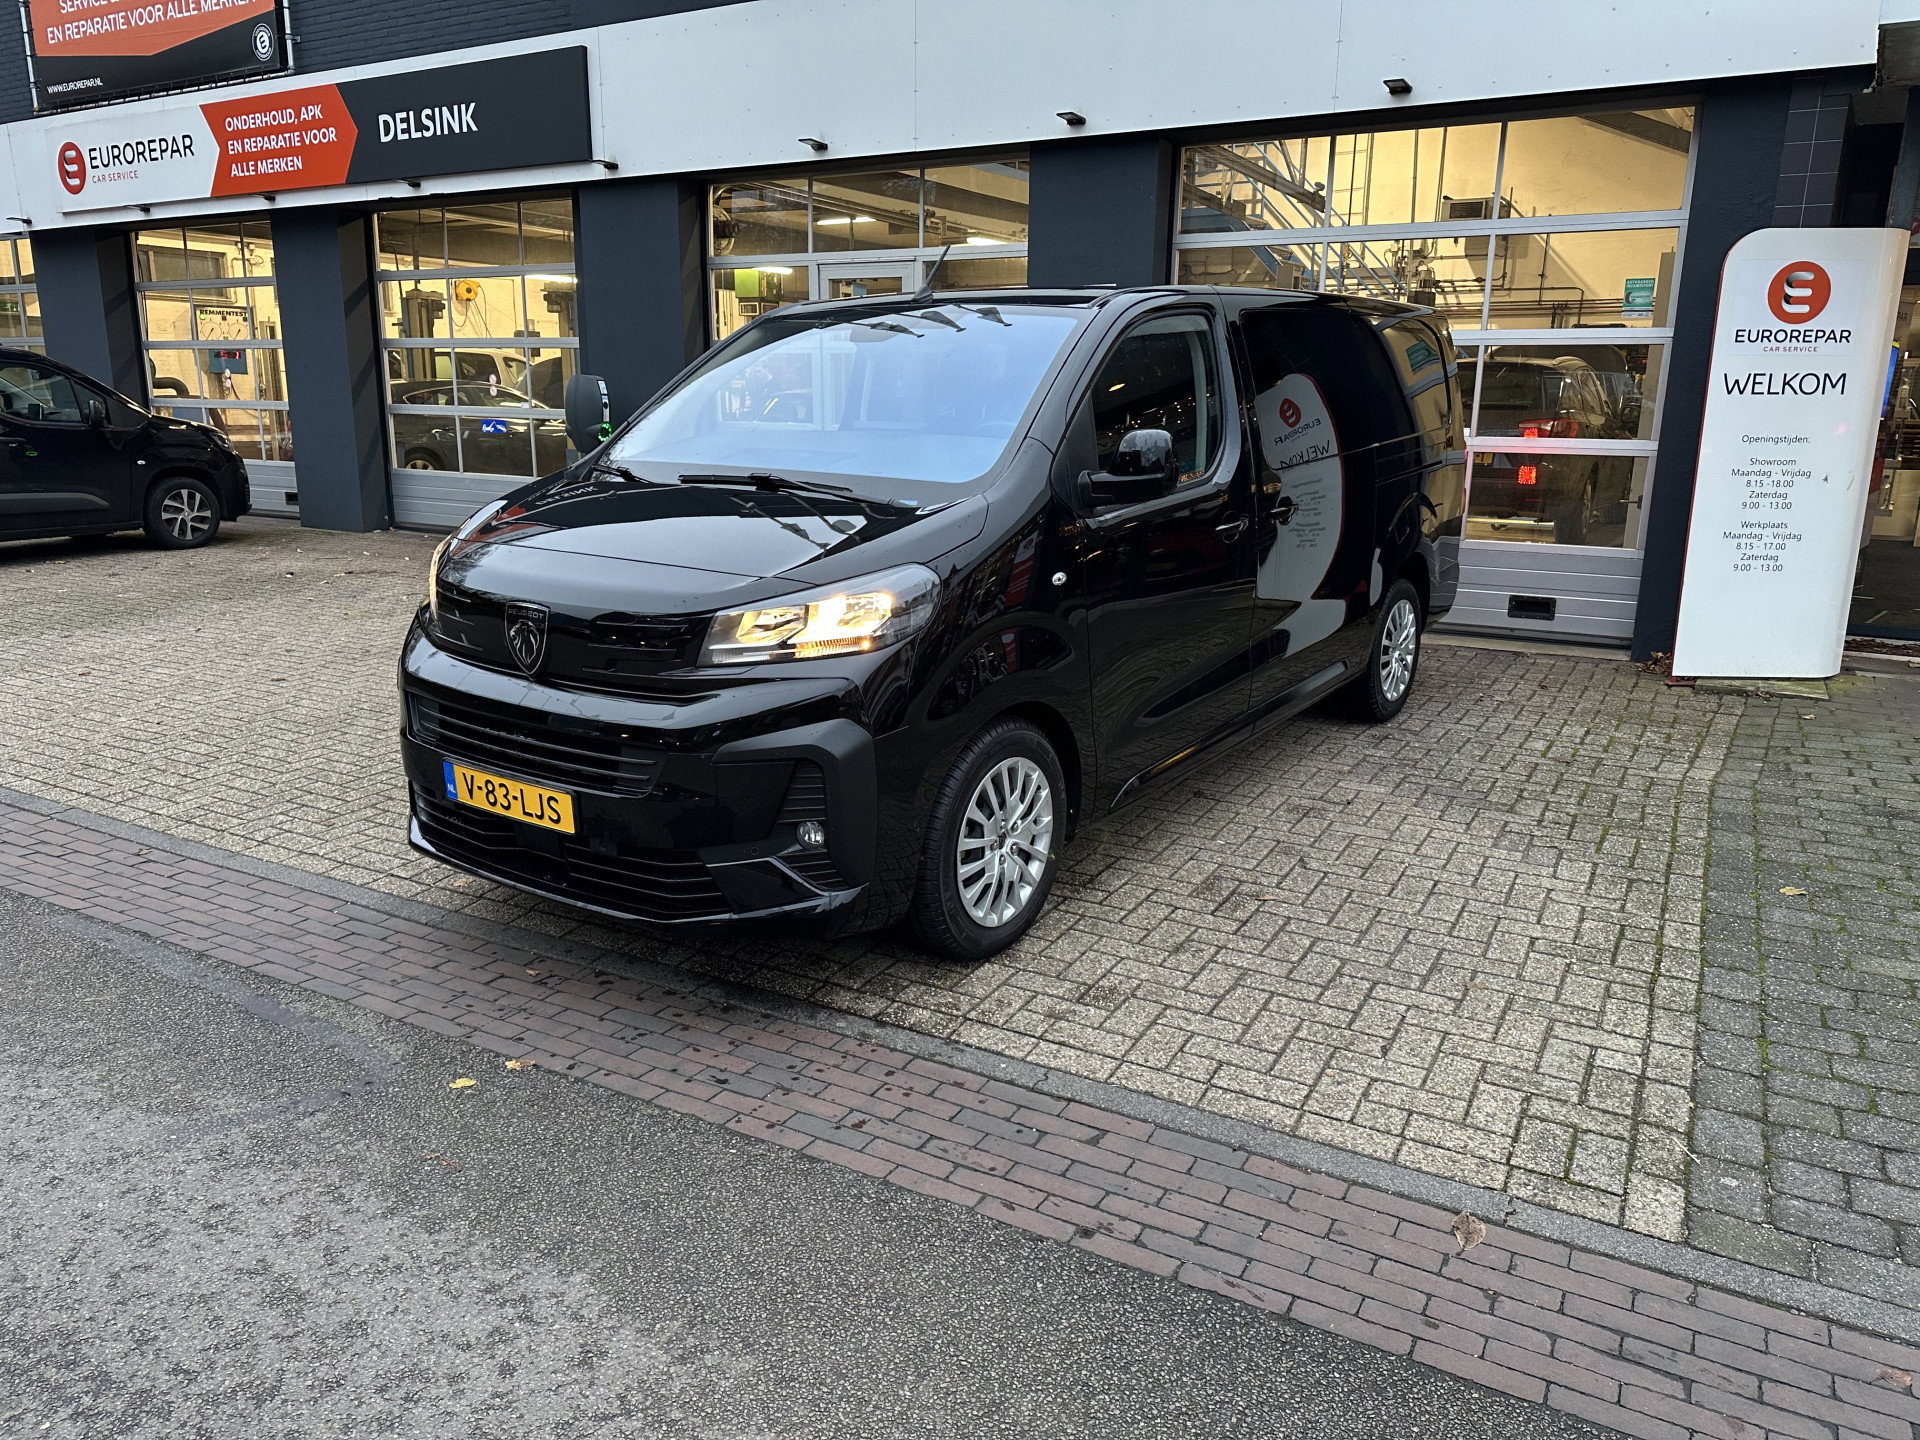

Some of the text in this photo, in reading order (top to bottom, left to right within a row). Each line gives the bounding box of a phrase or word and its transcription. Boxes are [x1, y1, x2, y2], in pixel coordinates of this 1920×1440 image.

[47, 26, 63, 44] EN
[65, 11, 128, 40] REPARATIE
[127, 4, 165, 28] VOOR
[166, 0, 199, 20] ALLE
[225, 104, 324, 132] ONDERHOUD, APK
[378, 102, 478, 143] DELSINK
[227, 126, 338, 155] EN REPARATIE VOOR
[88, 134, 194, 170] EUROREPAR
[230, 155, 303, 178] ALLE MERKEN
[91, 170, 139, 184] CAR SERVICE
[1734, 329, 1852, 344] EUROREPAR
[1723, 373, 1847, 396] WELKOM
[1741, 434, 1811, 446] Openingstijden:
[1749, 457, 1797, 467] Showroom
[1731, 469, 1773, 479] Maandag
[1781, 469, 1812, 480] Vrijdag
[1745, 480, 1764, 488] 8.15
[1748, 490, 1788, 501] Zaterdag
[1741, 502, 1760, 510] 9.00
[1769, 502, 1793, 510] 13.00
[1741, 520, 1788, 530] Werkplaats
[1722, 531, 1763, 542] Maandag
[1772, 531, 1802, 542] Vrijdag
[1735, 542, 1754, 551] 8.15
[1763, 542, 1787, 551] 17.00
[1740, 553, 1779, 563] Zaterdag
[1733, 564, 1752, 572] 9.00
[1760, 564, 1783, 572] 13.00
[508, 608, 545, 620] PEUGEOT
[447, 783, 457, 794] NL
[462, 771, 562, 825] V-83-LJS
